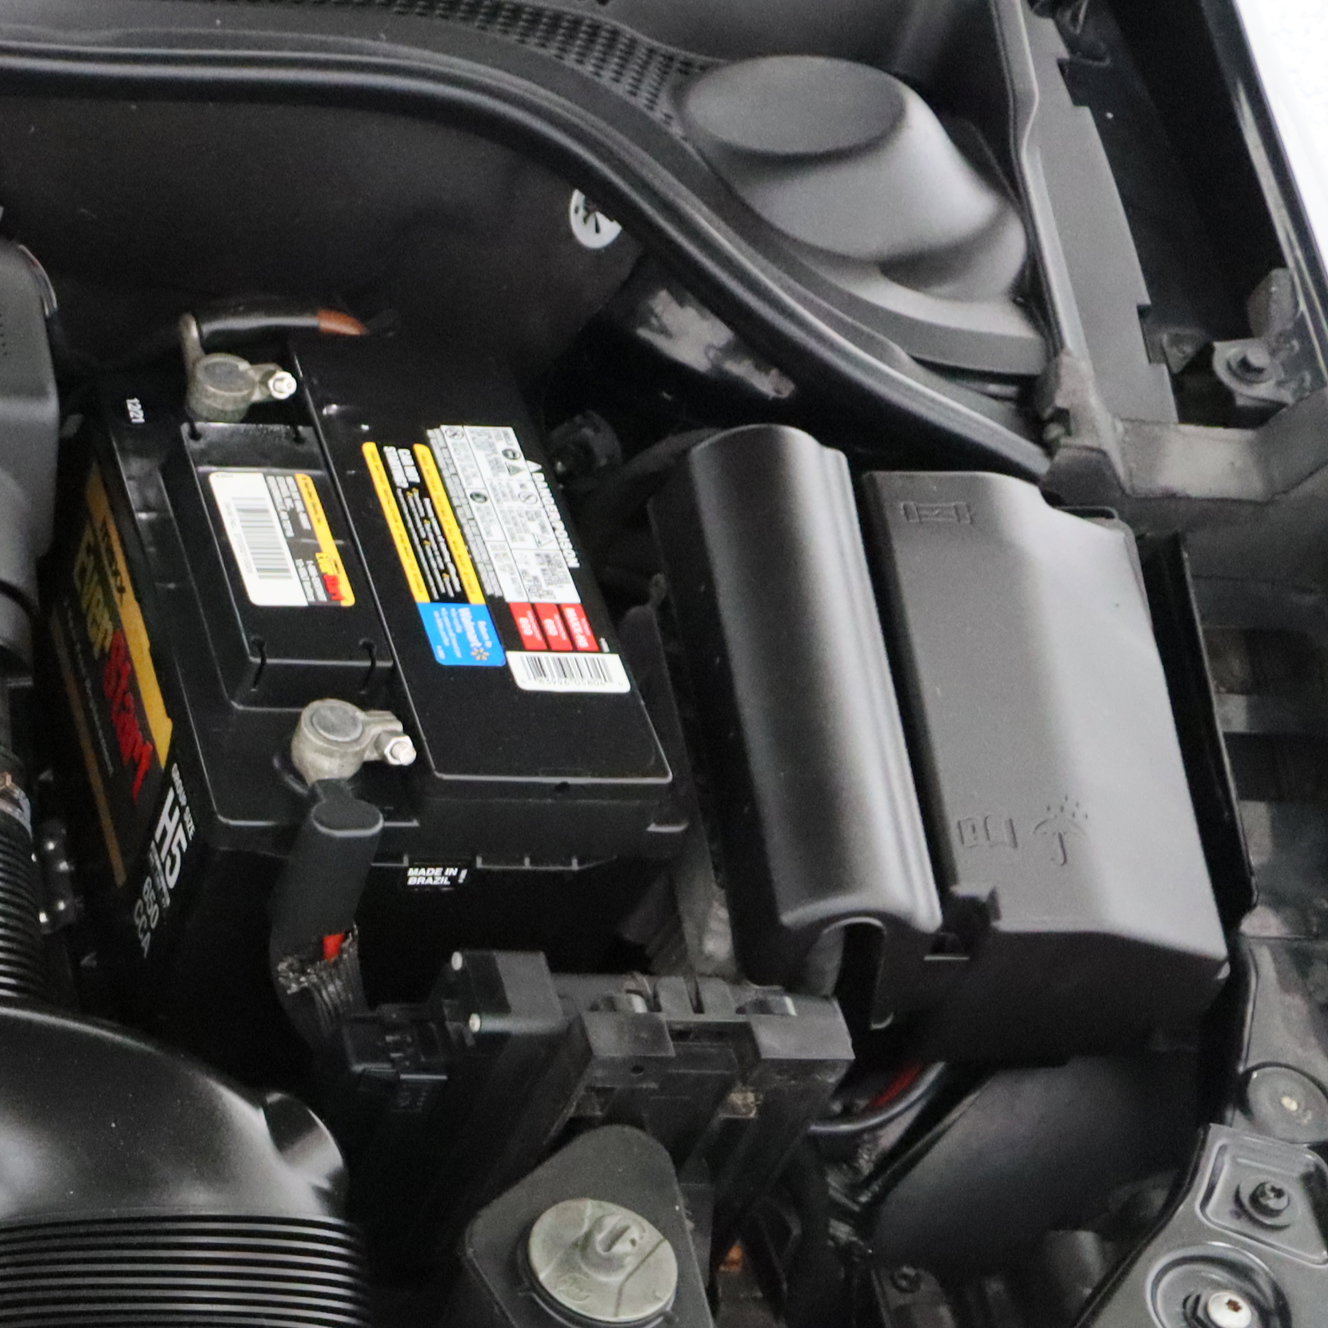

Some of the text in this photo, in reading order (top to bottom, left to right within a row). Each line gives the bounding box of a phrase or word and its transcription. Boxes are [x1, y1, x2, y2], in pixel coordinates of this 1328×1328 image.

[154, 786, 188, 889] H5
[407, 867, 459, 876] MADE IN
[407, 877, 451, 886] BRAZIL
[134, 898, 151, 959] CCA
[142, 876, 160, 929] 650
